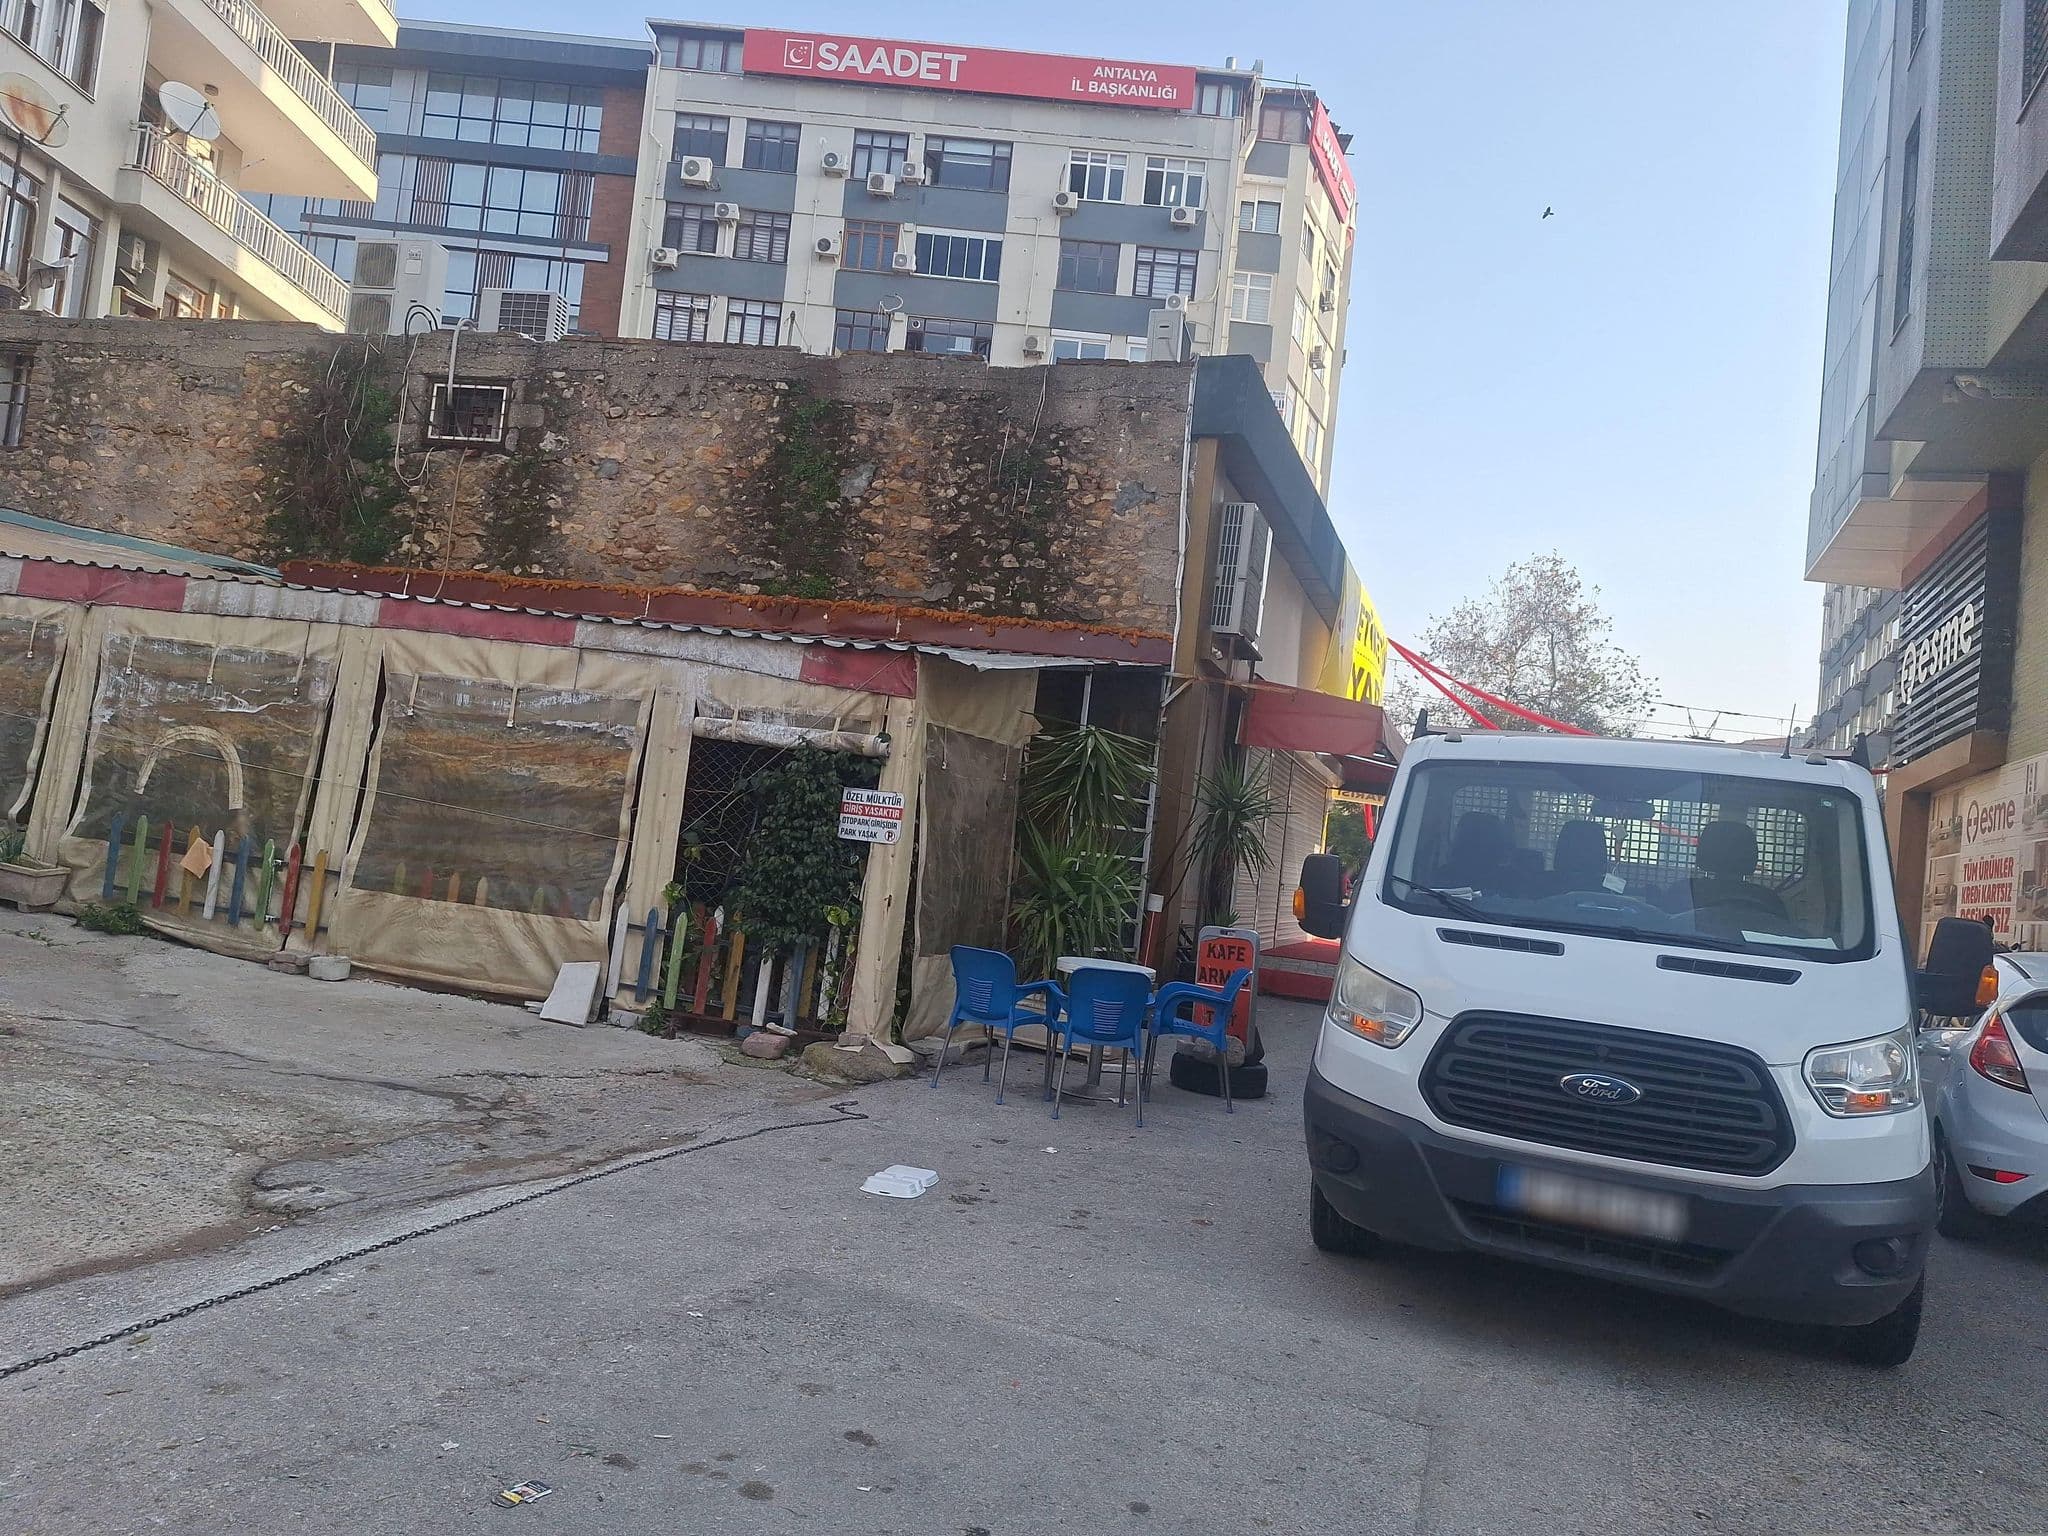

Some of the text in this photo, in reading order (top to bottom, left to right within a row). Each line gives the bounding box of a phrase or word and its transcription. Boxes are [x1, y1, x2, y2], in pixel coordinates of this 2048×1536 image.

[816, 42, 967, 82] SAADET
[1093, 66, 1158, 82] ANTALYA
[1071, 76, 1177, 100] İL BAŞKANLIĞI
[1918, 603, 1975, 684] esme
[846, 791, 901, 806] ÖZEL MÜLKTÜR
[842, 817, 870, 826] OTOPARK
[864, 805, 900, 818] YASAKTIR
[1979, 799, 2016, 836] esme
[841, 827, 877, 838] PARK YASAK
[1963, 854, 2014, 882] TÜM ÜRÜNLER
[1961, 882, 2013, 904] KREDİ KARTSIZ
[1207, 943, 1245, 961] KAFE
[1577, 1078, 1621, 1100] Ford
